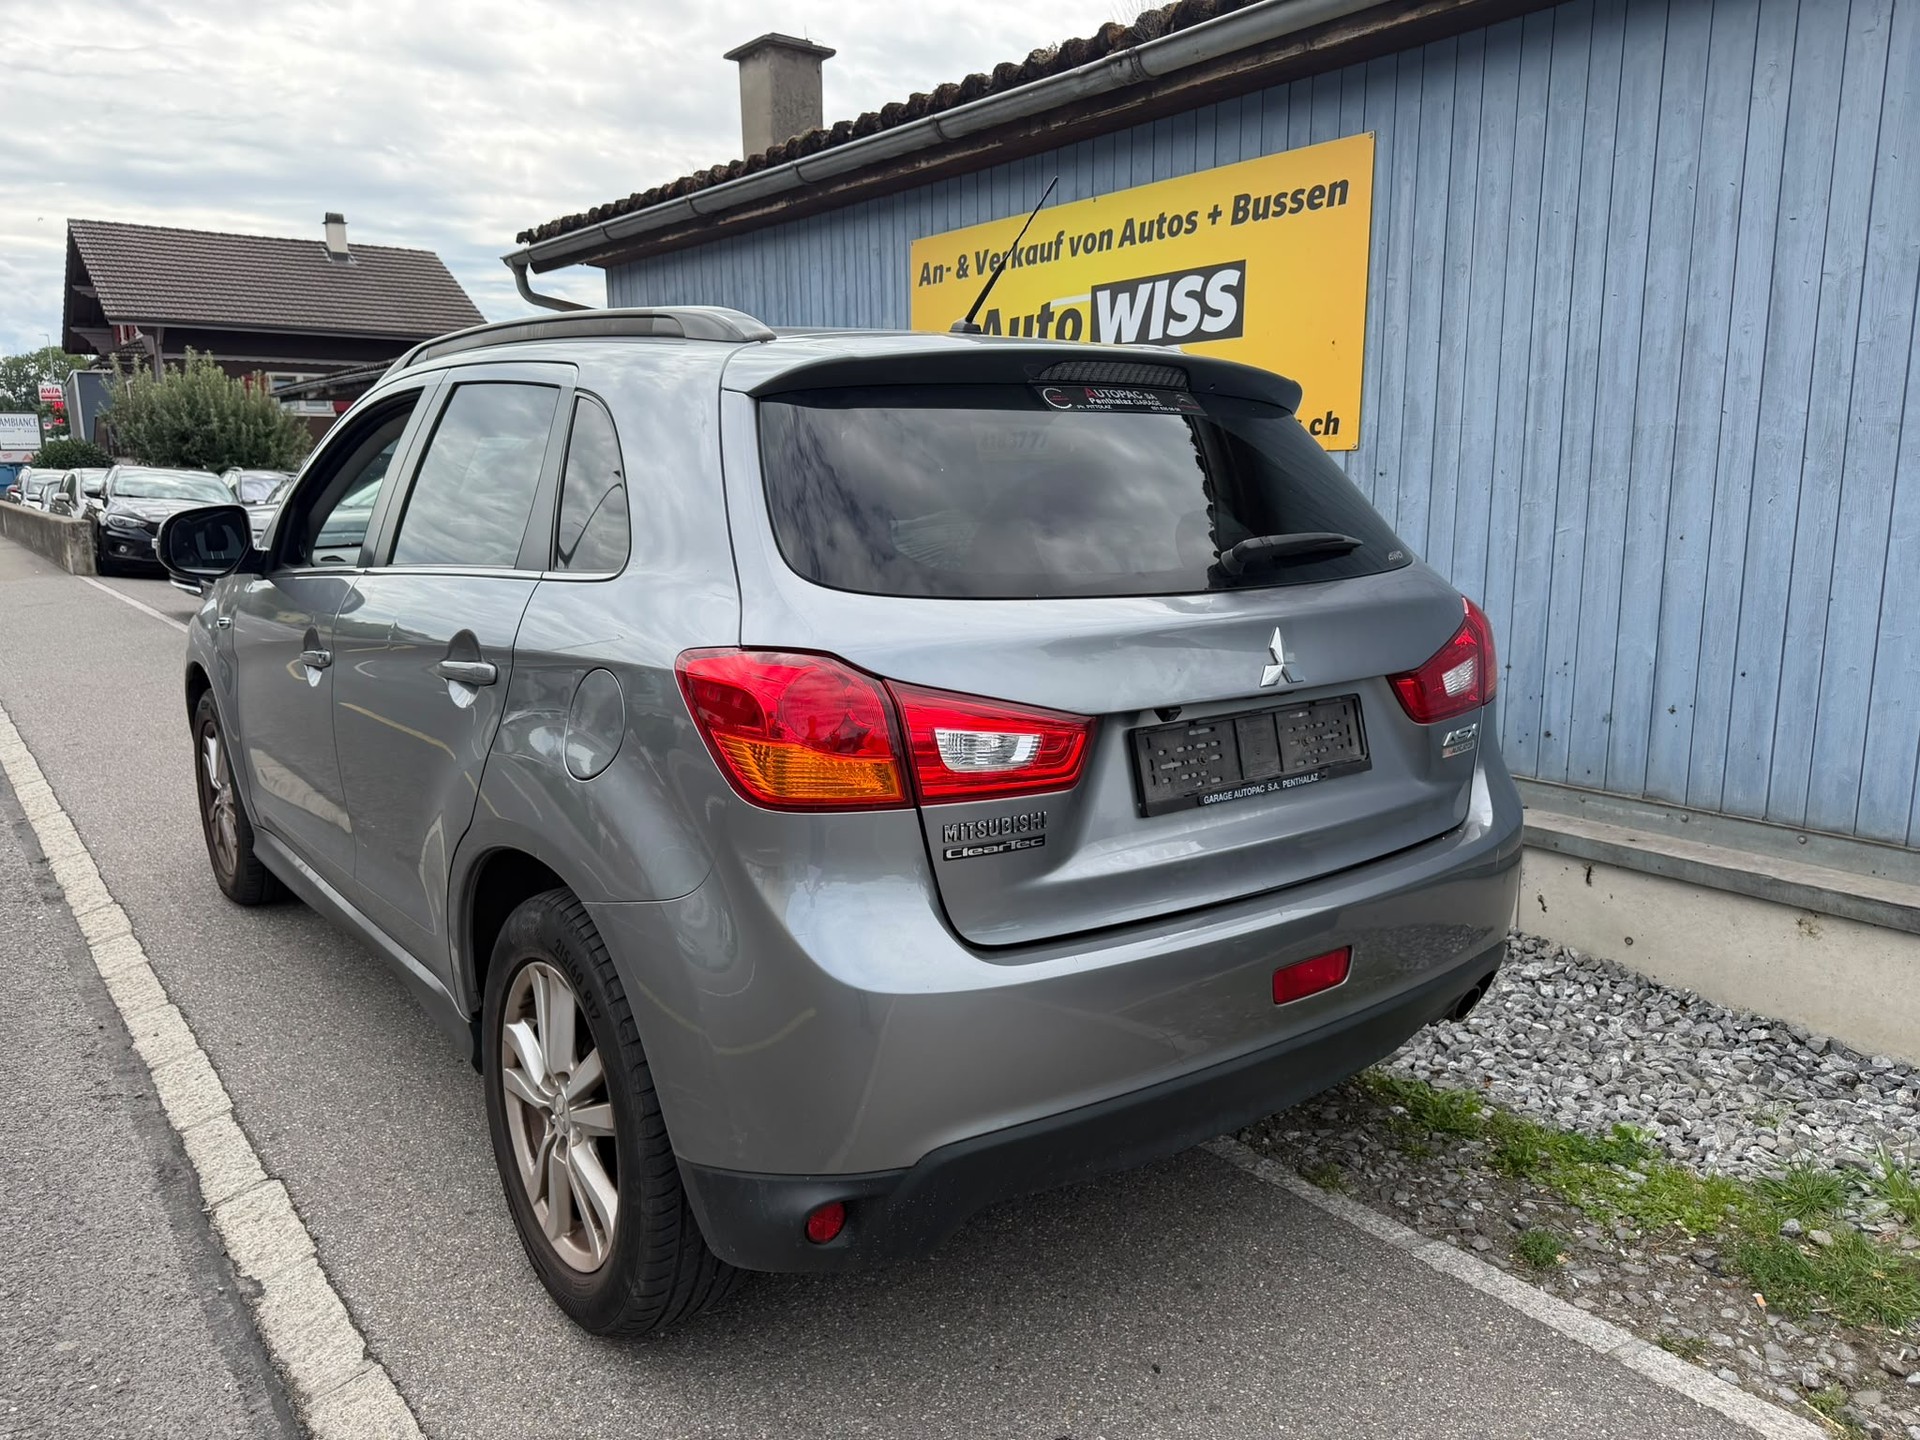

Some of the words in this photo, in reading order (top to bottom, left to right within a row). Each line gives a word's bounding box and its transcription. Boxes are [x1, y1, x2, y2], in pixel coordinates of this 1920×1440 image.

[918, 262, 951, 287] An-
[956, 254, 969, 280] &
[975, 230, 1064, 276] Verkauf
[1069, 228, 1113, 257] von
[1118, 211, 1198, 248] Autos
[1207, 204, 1222, 226] +
[1230, 179, 1349, 226] Bussen
[983, 302, 1083, 341] Auto
[1096, 269, 1241, 344] WISS
[40, 387, 61, 395] AVIA
[1085, 387, 1143, 399] AUTOPAC
[1088, 397, 1133, 405] Penthalaz
[0, 417, 37, 428] AMBIANCE
[1442, 723, 1477, 746] ASX
[1203, 792, 1233, 804] GARAGE
[1233, 785, 1265, 798] AUTOPAC
[1282, 773, 1319, 788] PENTHALAZ
[943, 811, 1047, 843] MITSUBISHI
[946, 838, 1043, 859] ClearTec
